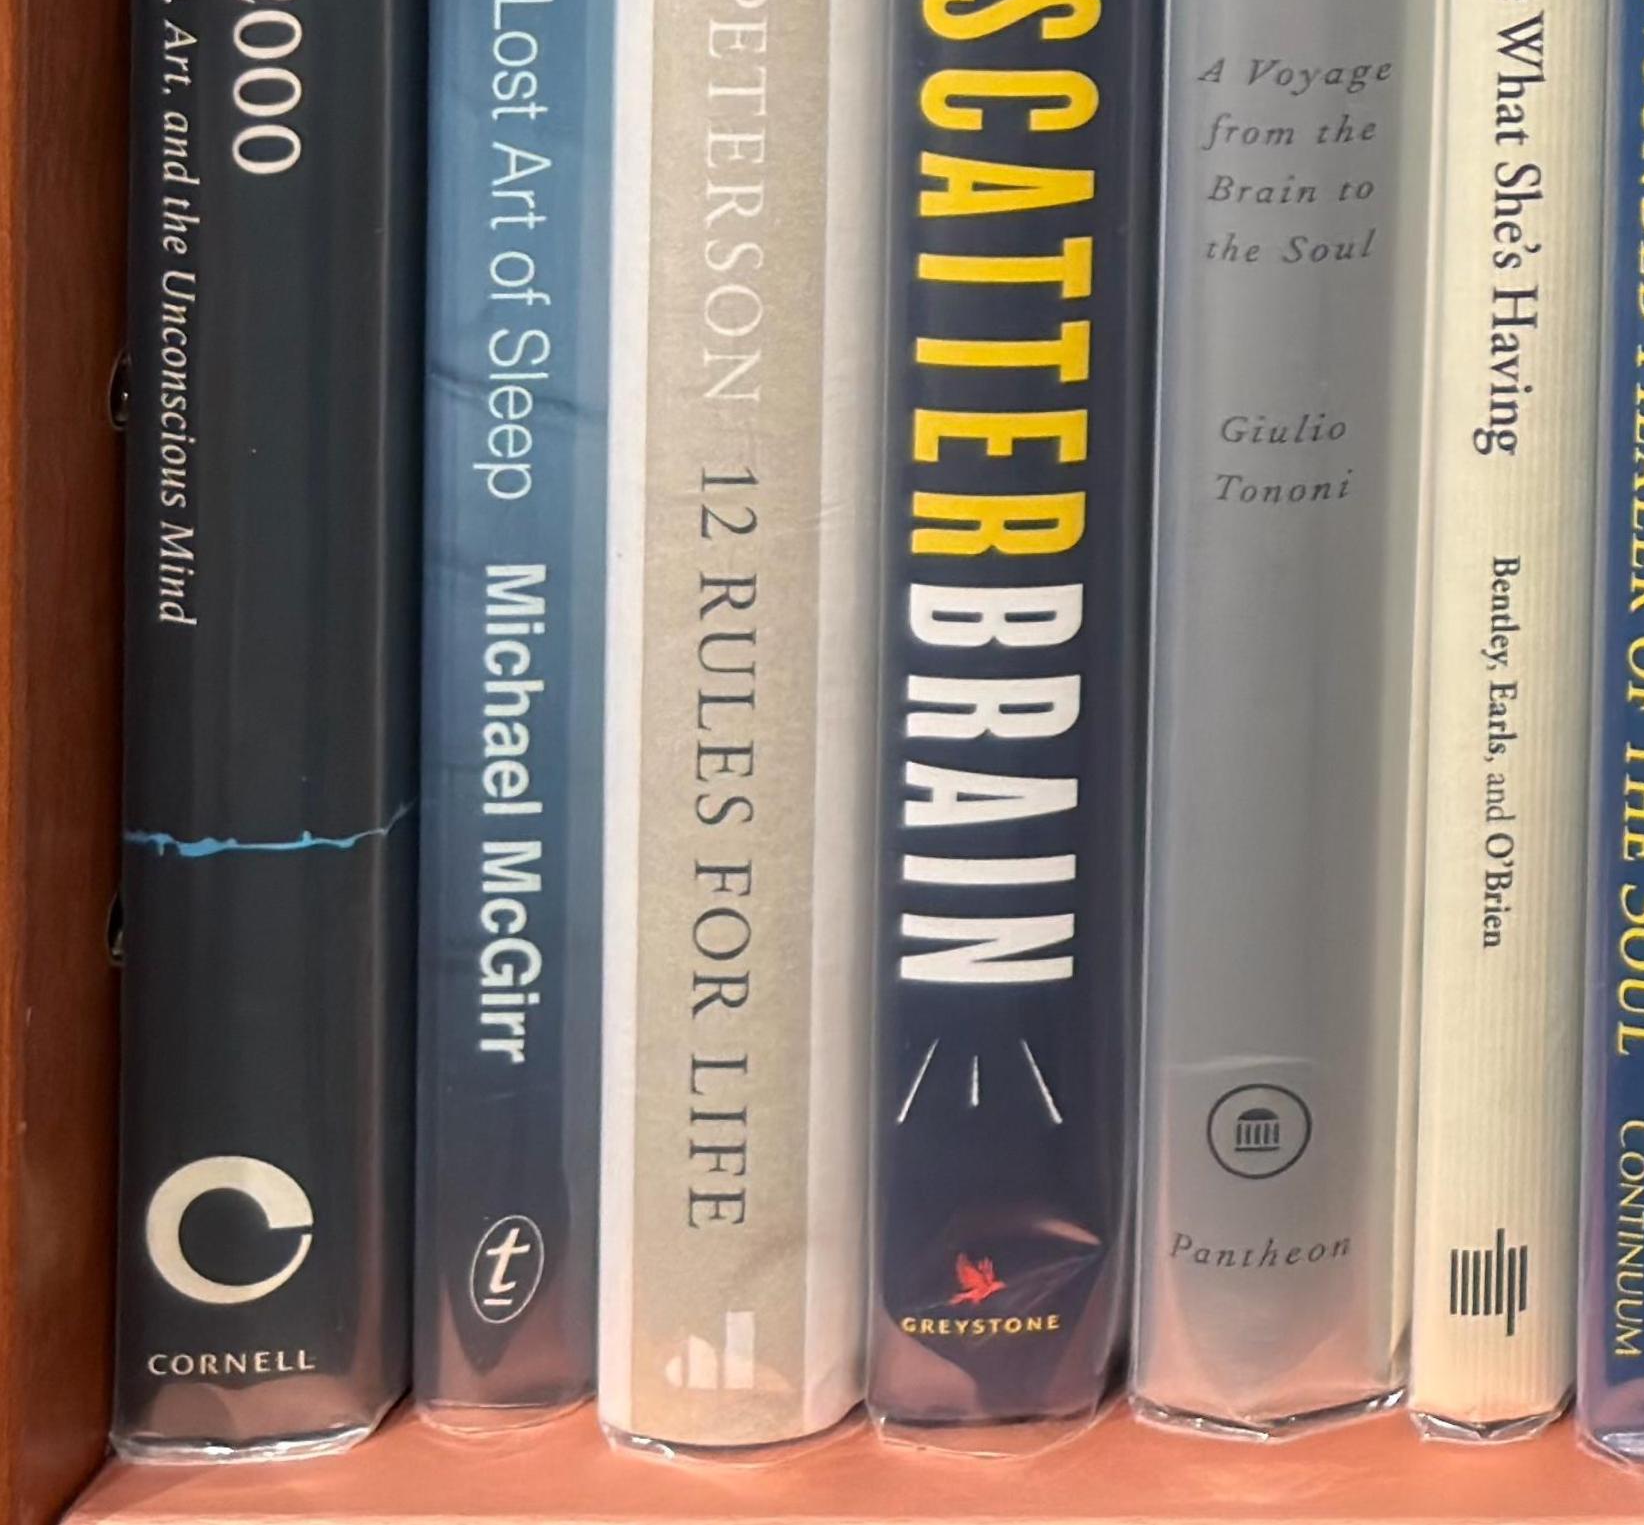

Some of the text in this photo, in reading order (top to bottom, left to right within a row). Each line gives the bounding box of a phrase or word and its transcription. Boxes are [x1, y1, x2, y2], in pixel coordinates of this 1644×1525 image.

[164, 19, 200, 97] Art,
[1198, 56, 1394, 96] A Voyage
[1495, 11, 1546, 146] What
[162, 110, 199, 188] and
[1201, 115, 1377, 151] from the
[489, 143, 553, 231] Art
[1207, 174, 1374, 205] Brain to
[1492, 162, 1543, 270] She's
[162, 195, 199, 258] the
[1206, 229, 1375, 264] the Soul
[489, 250, 552, 306] of
[160, 270, 199, 509] Unconscious
[1473, 286, 1538, 456] Having
[473, 331, 551, 501] Sleep
[1221, 416, 1346, 445] Giulio
[700, 466, 758, 539] 12
[1214, 469, 1355, 505] Tononi
[159, 521, 197, 625] Mind
[480, 564, 547, 816] Michael
[690, 572, 758, 828] RULES
[1481, 556, 1520, 950] Bentley, Earls, and O'Brien
[478, 841, 543, 1064] McGirr
[690, 861, 752, 1017] FOR
[687, 1055, 750, 1230] LIFE
[1168, 1231, 1352, 1269] Pantheon
[148, 1350, 314, 1377] CORNELL
[901, 1314, 1061, 1338] GREYSTONE
